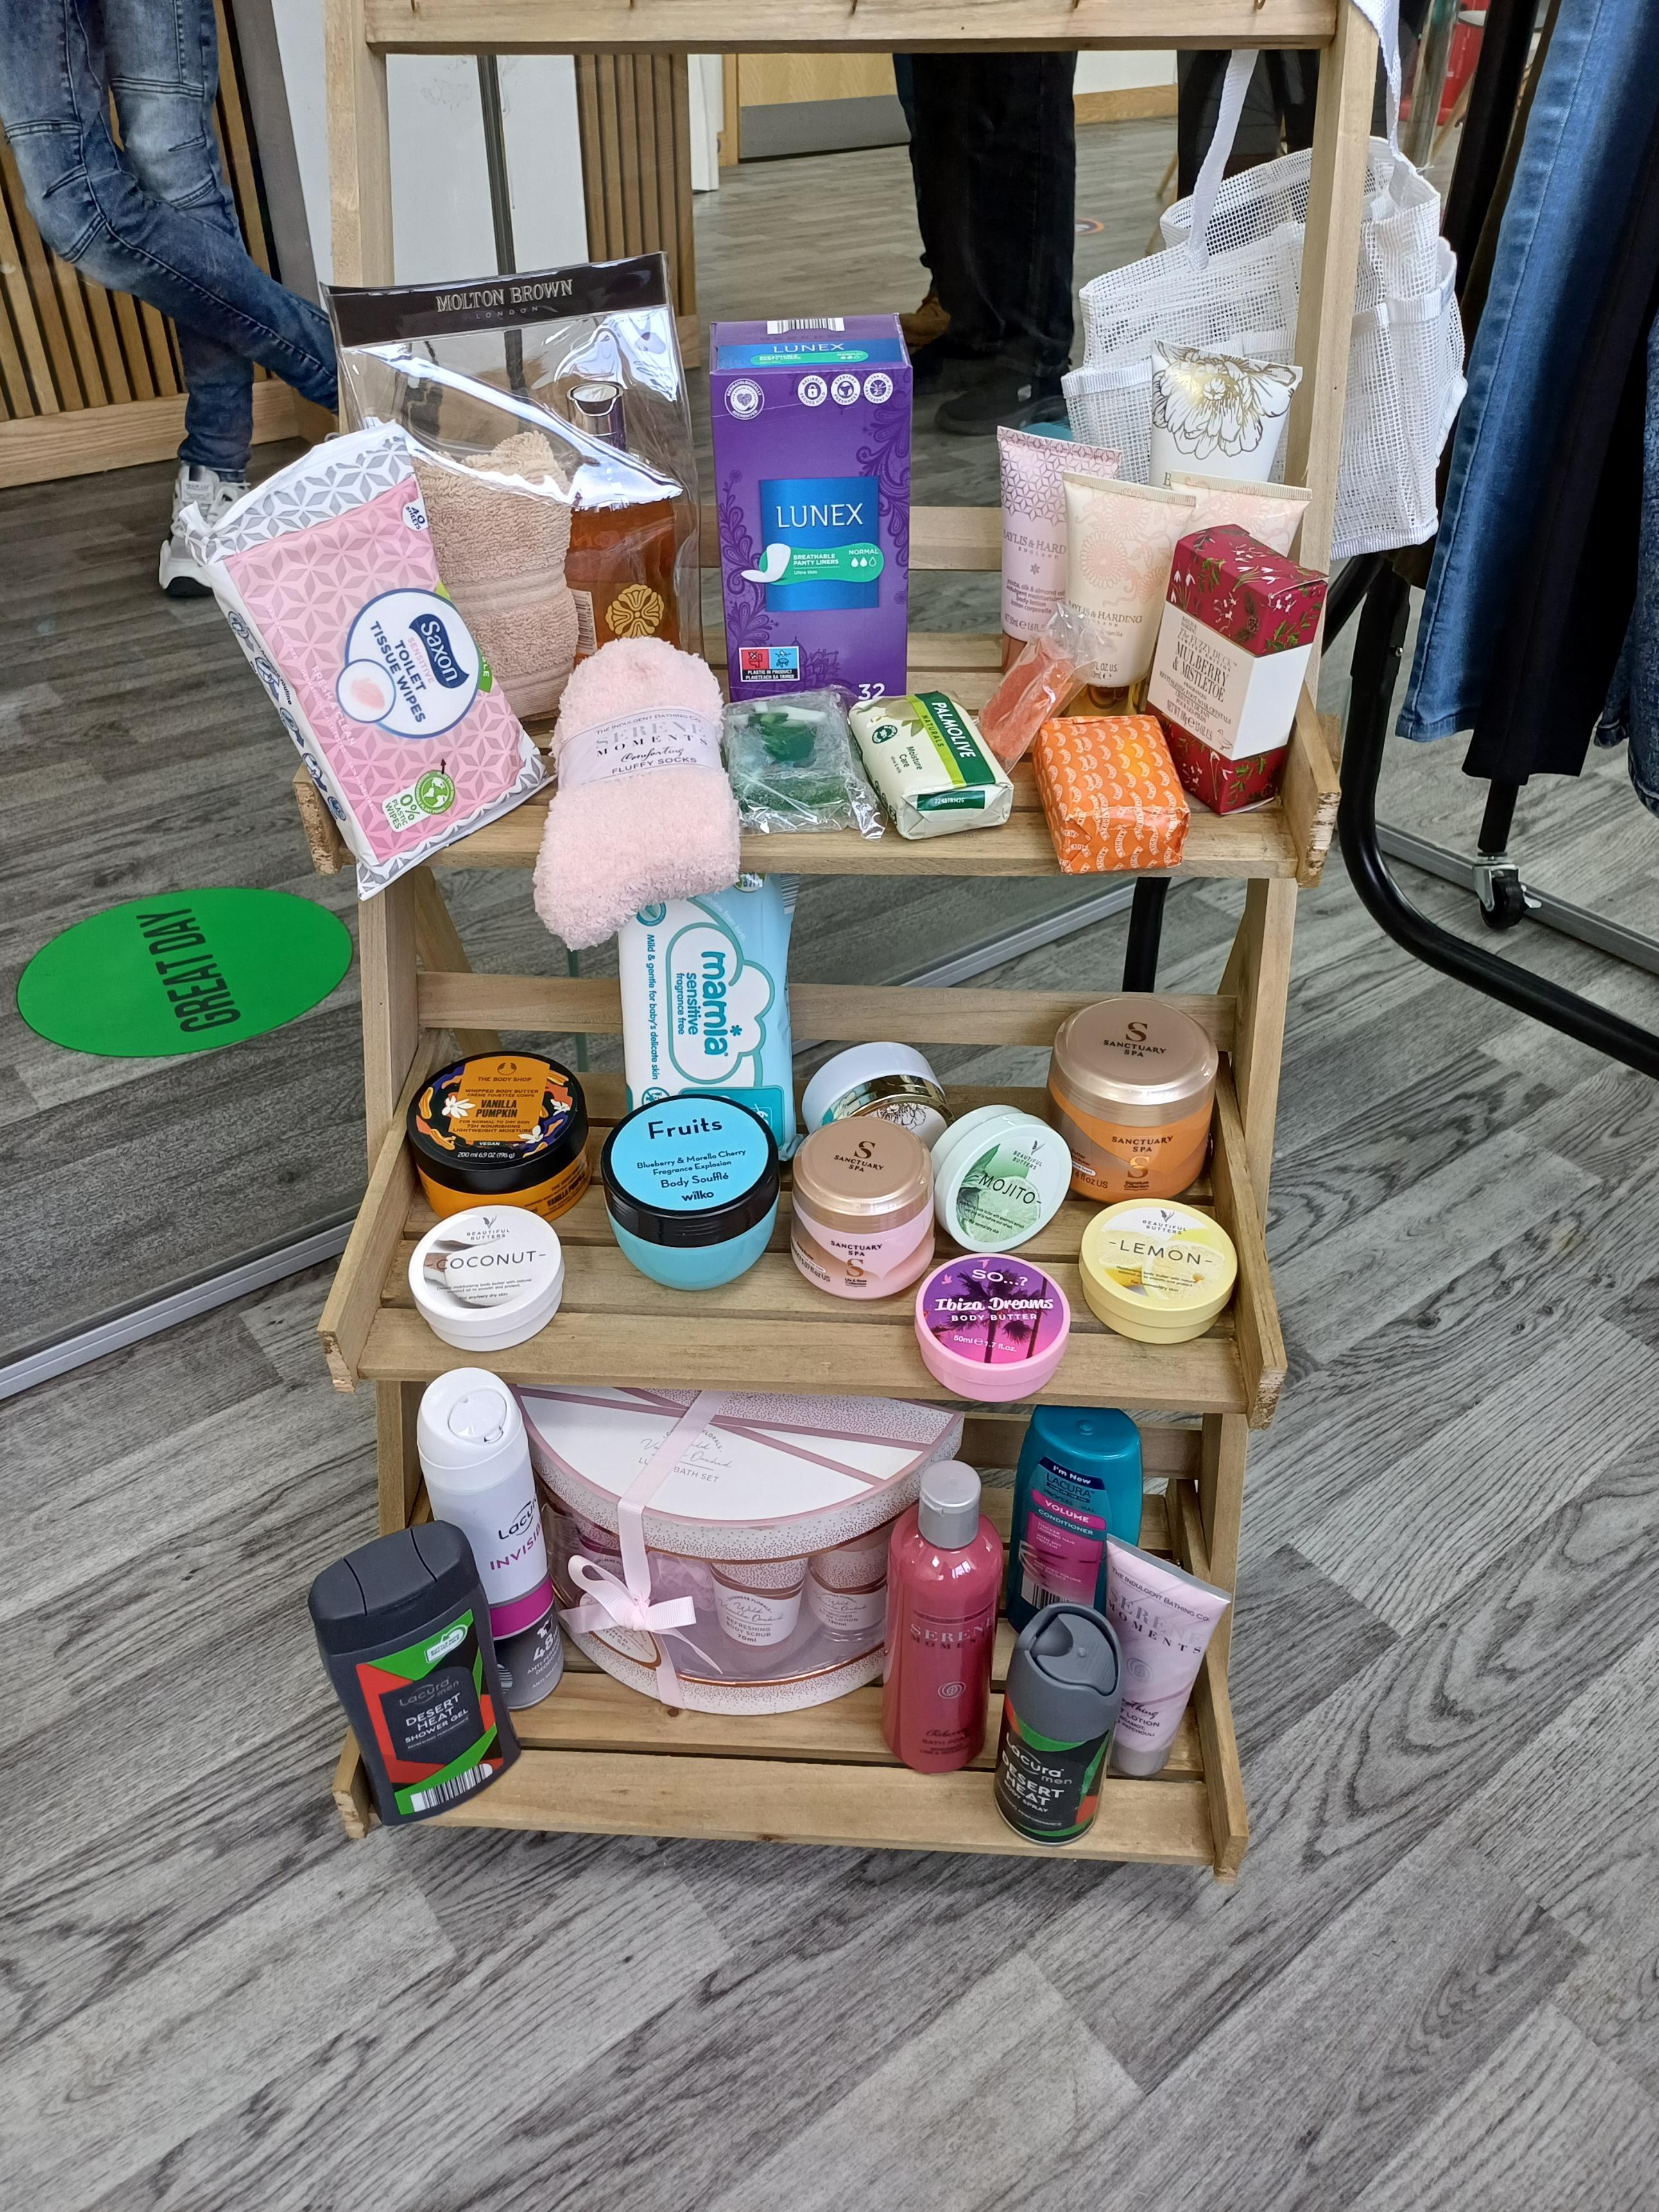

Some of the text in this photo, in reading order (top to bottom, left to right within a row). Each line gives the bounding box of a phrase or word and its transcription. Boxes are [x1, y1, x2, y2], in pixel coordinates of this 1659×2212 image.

[436, 279, 573, 313] MOLTON BROWN
[476, 305, 539, 320] LONDON
[773, 343, 845, 354] LUNEX
[405, 506, 422, 530] SHEETS
[411, 506, 425, 525] 40
[776, 503, 863, 528] LUNEX
[1097, 611, 1142, 624] HARDING
[407, 637, 434, 684] SENSITIVE
[420, 621, 458, 682] Saxon
[1191, 634, 1210, 654] FUZZY
[1212, 649, 1232, 669] DUCK
[370, 621, 426, 723] TISSUE WIPES
[395, 639, 426, 691] TOILET
[1176, 641, 1228, 687] MULBERRY
[1173, 656, 1225, 703] & MISTLETOE
[857, 683, 886, 701] 32
[312, 665, 334, 701] FRESH
[334, 711, 357, 746] CLEAN
[596, 721, 704, 749] SERENE
[922, 714, 945, 748] NATURALS
[931, 701, 976, 759] PALMOLIVE
[596, 734, 708, 757] MOMENTS
[621, 746, 685, 763] Comforting
[612, 757, 697, 774] FLUFFY SOCKS
[898, 753, 910, 768] Care
[906, 746, 923, 771] Moisture
[385, 802, 402, 830] WIPES
[391, 799, 409, 827] PLASTIC
[400, 794, 420, 821] 0%
[646, 934, 655, 953] Mild
[136, 908, 241, 1033] GREAT DAY
[646, 963, 656, 989] gentle
[675, 972, 684, 1015] fragrance
[686, 972, 701, 1035] sensitive
[701, 951, 729, 1056] mamia
[648, 1002, 657, 1029] baby's
[1125, 1022, 1148, 1042] S
[649, 1031, 658, 1063] delicate
[1103, 1039, 1167, 1054] SANCTUARY
[1124, 1049, 1144, 1058] SPA
[476, 1108, 518, 1119] PUMPKIN
[481, 1099, 517, 1109] VANILLA
[648, 1118, 723, 1140] Fruits
[854, 1140, 875, 1159] S
[1112, 1135, 1173, 1145] SANCTUARY
[637, 1159, 676, 1170] Blueberry
[686, 1153, 717, 1163] Morello
[718, 1149, 746, 1158] Cherry
[653, 1160, 732, 1176] Fragrance Explosion
[834, 1154, 884, 1171] SANCTUARY
[848, 1163, 865, 1172] SPA
[1012, 1156, 1037, 1170] BUTTERS
[1013, 1150, 1042, 1167] BEAUTIFUL
[1127, 1156, 1150, 1179] S
[661, 1172, 729, 1188] Body Soufflé
[682, 1190, 714, 1202] wilko
[1142, 1219, 1187, 1231] BEAUTIFUL
[1146, 1225, 1182, 1235] BUTTERS
[830, 1240, 882, 1250] SANCTUARY
[846, 1258, 865, 1278] S
[971, 1269, 1028, 1287] SO...?
[934, 1297, 1054, 1312] Ibiza Dreams
[954, 1335, 974, 1344] 50ml
[702, 1430, 723, 1450] FLORALS
[690, 1451, 733, 1468] Orchid
[674, 1466, 719, 1483] BATH SET
[1053, 1465, 1092, 1485] I'm New
[1047, 1472, 1092, 1499] LACURA
[499, 1495, 537, 1540] Lacur
[1038, 1508, 1094, 1536] CONDITIONER
[1045, 1499, 1090, 1524] VOLUME
[490, 1521, 542, 1571] INVISIB
[1112, 1567, 1124, 1581] THE
[1124, 1577, 1164, 1601] INDULGENT
[1164, 1597, 1196, 1618] BATHING
[726, 1616, 771, 1632] REFRESHING
[1110, 1587, 1207, 1643] SERENE
[726, 1621, 744, 1633] BODY
[1108, 1599, 1202, 1654] MOMENTS
[737, 1634, 757, 1643] 70ml
[399, 1677, 450, 1707] Lacura
[437, 1679, 460, 1697] men
[406, 1692, 461, 1727] DESERT
[417, 1706, 454, 1731] HEAT
[1126, 1711, 1160, 1727] LOTION
[405, 1708, 468, 1744] SHOWER GEL
[1122, 1722, 1155, 1736] PATCHOULI
[1006, 1732, 1062, 1778] Lacura
[1002, 1749, 1065, 1798] DESERT
[1041, 1775, 1072, 1785] men
[1006, 1770, 1051, 1806] HEAT
[1022, 1798, 1049, 1812] SPRAY
